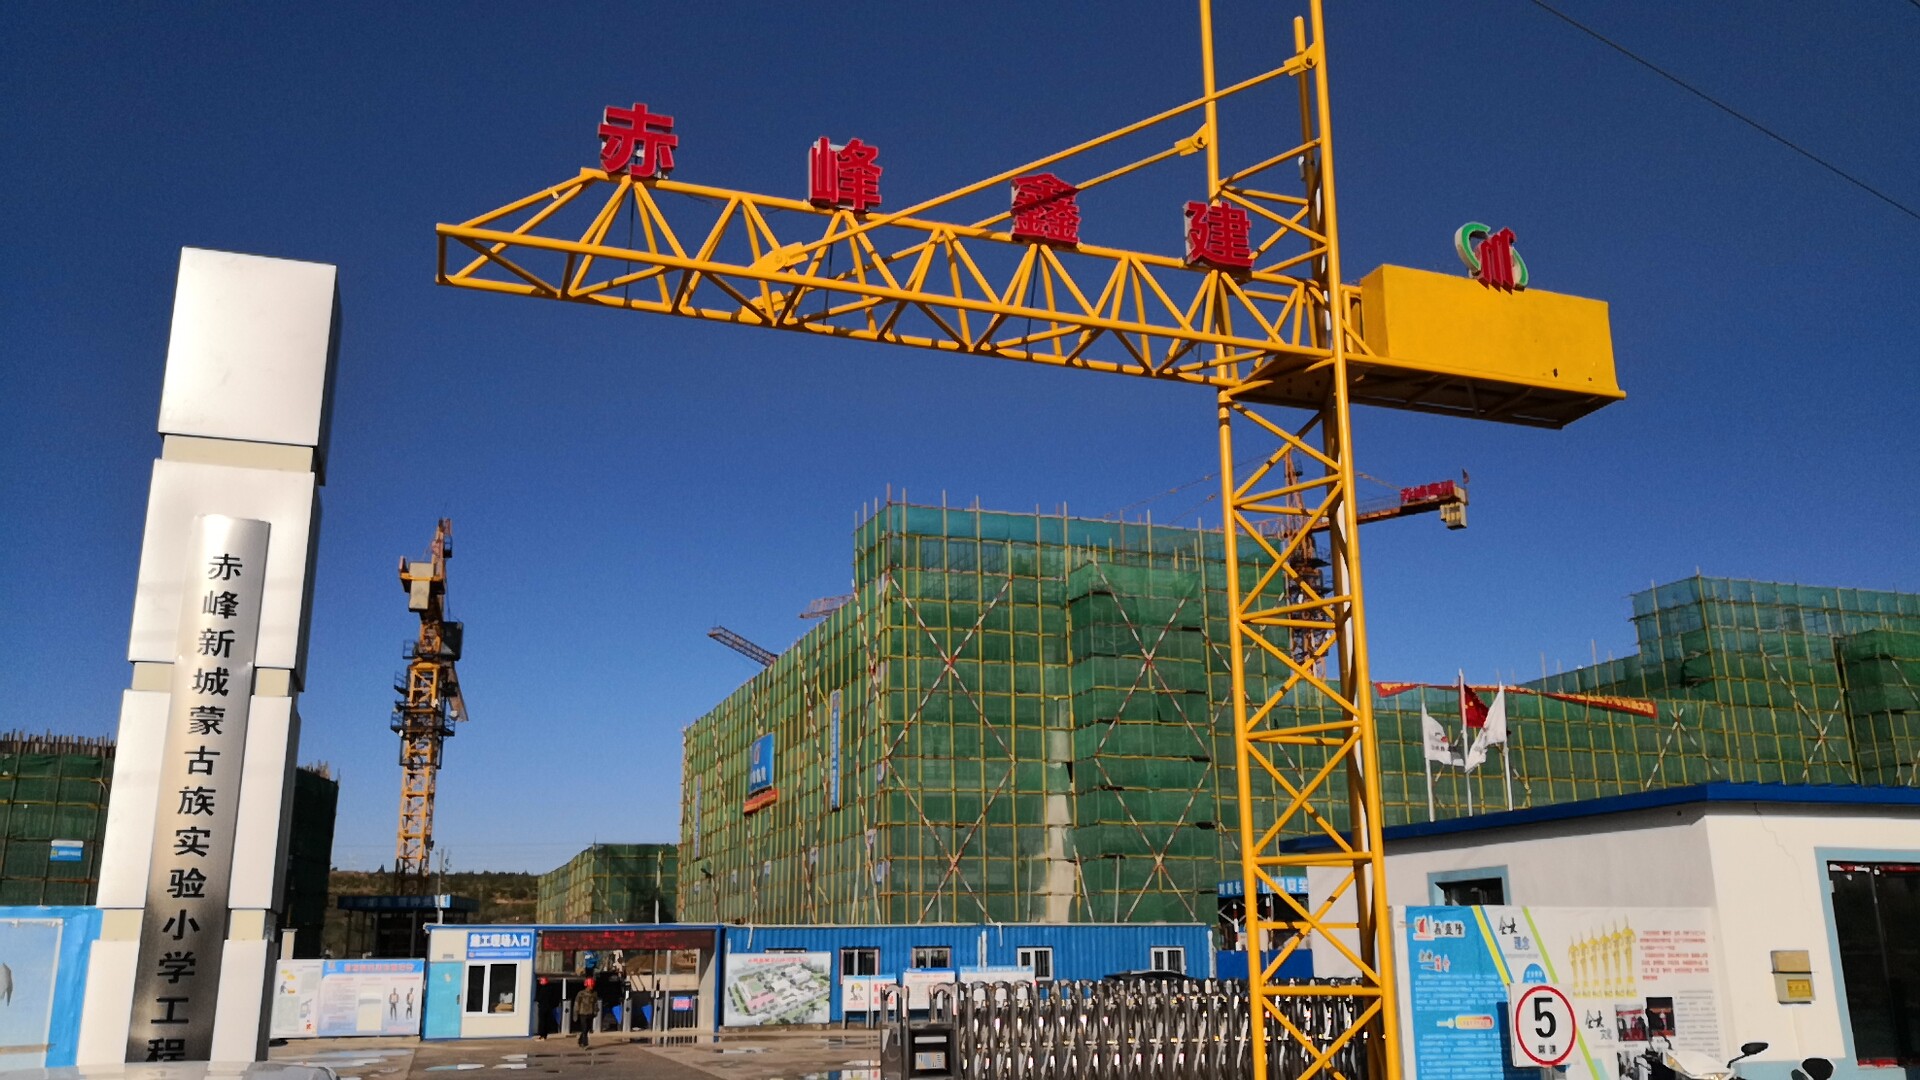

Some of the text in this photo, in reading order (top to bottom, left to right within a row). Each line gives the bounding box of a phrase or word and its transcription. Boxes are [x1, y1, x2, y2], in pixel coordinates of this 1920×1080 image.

[146, 554, 243, 1062] 赤峰新城蒙古族实验小学工程
[1534, 997, 1557, 1038] 5
